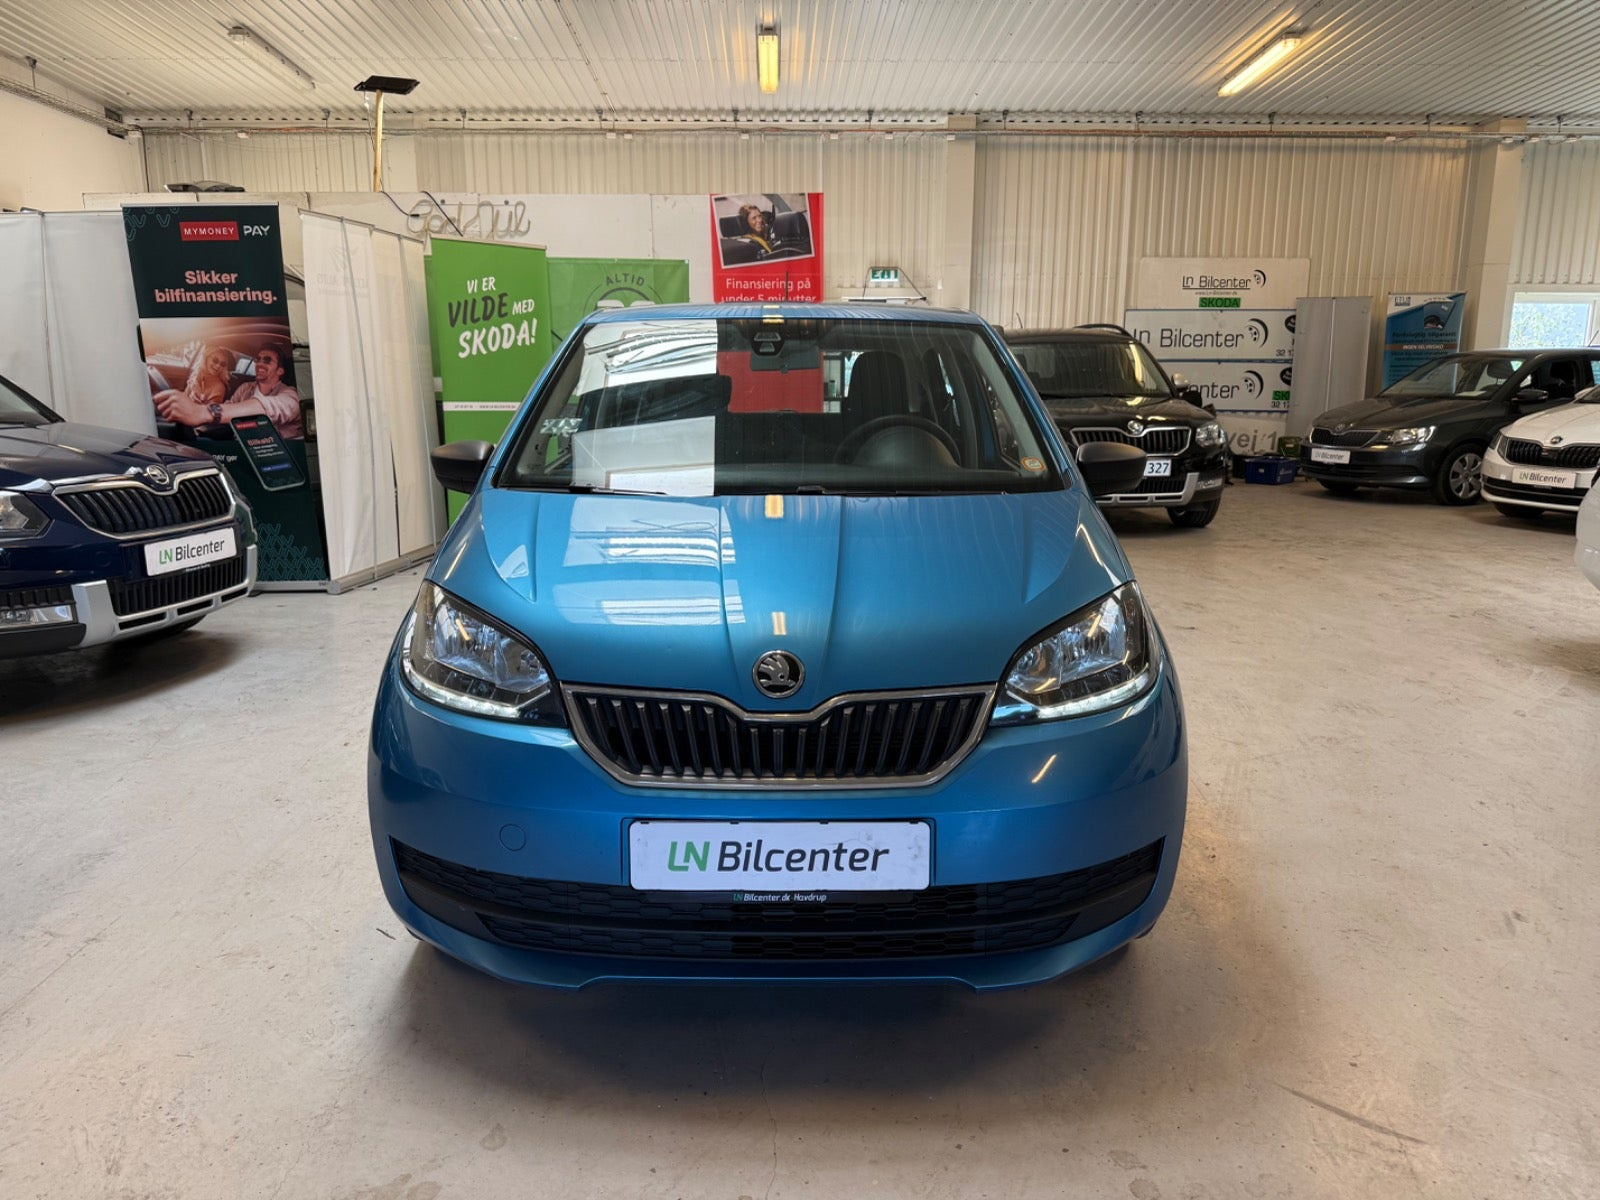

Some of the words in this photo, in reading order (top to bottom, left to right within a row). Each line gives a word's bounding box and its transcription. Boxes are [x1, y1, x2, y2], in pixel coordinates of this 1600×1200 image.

[184, 227, 235, 236] MYMONEY
[243, 225, 270, 236] PAY
[184, 269, 238, 284] Sikker
[605, 272, 645, 287] ALTID
[1199, 275, 1252, 289] Bilcenter
[466, 279, 478, 294] VI
[482, 276, 496, 292] ER
[725, 277, 794, 292] Finansiering
[797, 277, 811, 292] på
[154, 287, 278, 305] bilfinansiering.
[1200, 297, 1240, 308] SKODA
[447, 292, 508, 329] VILDE
[511, 299, 535, 316] MED
[458, 317, 538, 359] SKODA!
[1160, 327, 1245, 348] Bilcenter
[1147, 462, 1170, 475] 327
[1529, 472, 1567, 484] Bilcenter
[159, 548, 173, 566] LN
[175, 540, 225, 562] Bilcenter
[667, 841, 710, 872] LN
[717, 839, 890, 872] Bilcenter
[793, 893, 827, 904] Havdrup
